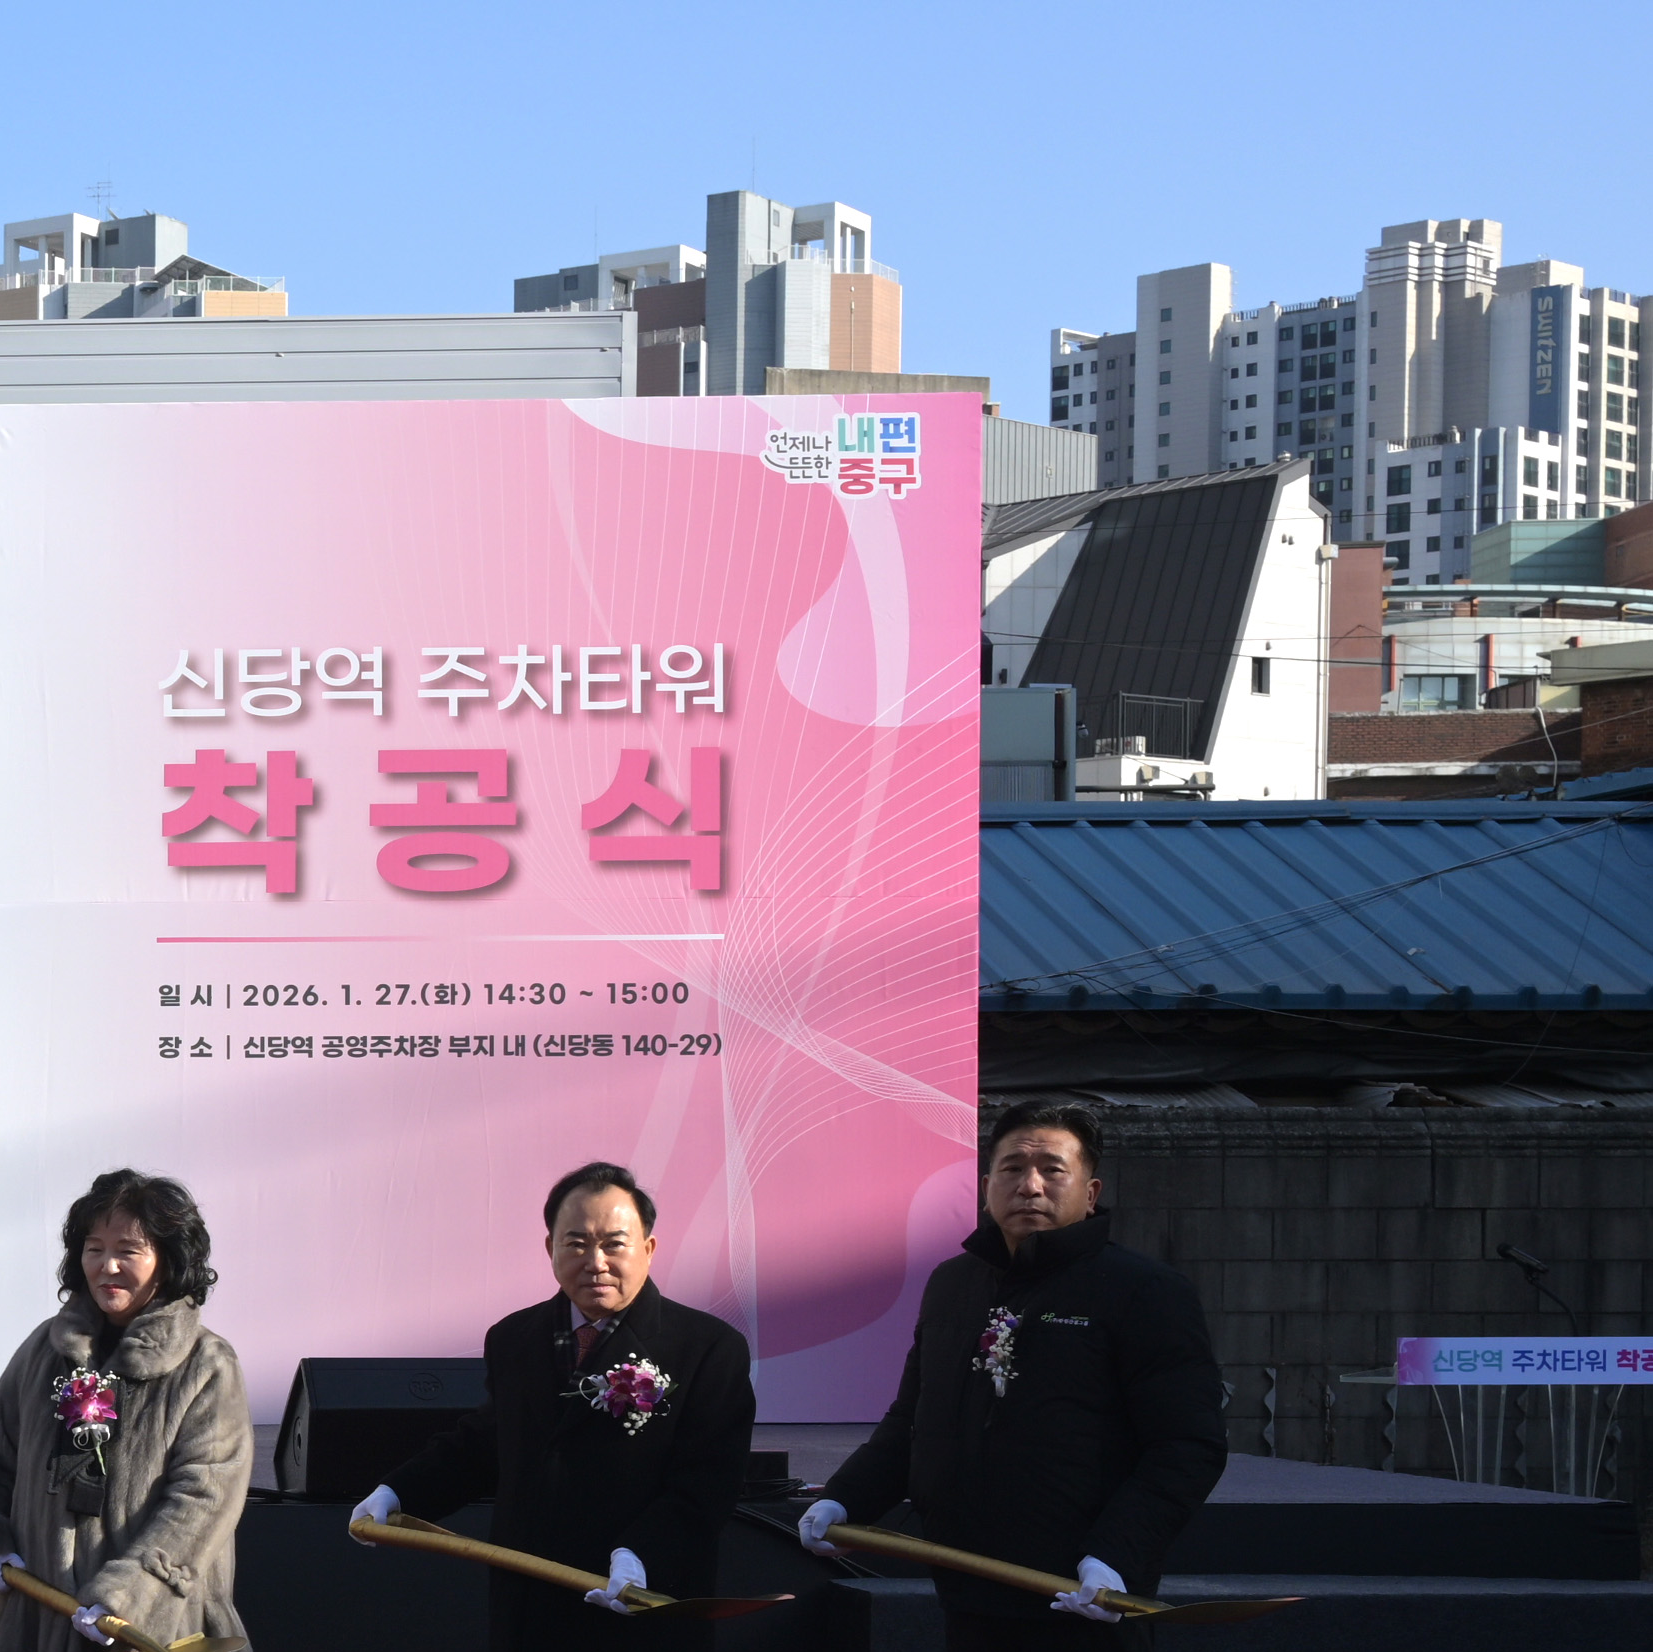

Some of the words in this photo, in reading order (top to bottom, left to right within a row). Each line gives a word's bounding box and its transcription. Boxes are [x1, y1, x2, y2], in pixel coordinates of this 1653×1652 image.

[770, 432, 832, 453] 언제나
[838, 417, 916, 453] 내편
[838, 458, 916, 495] 중구
[158, 647, 385, 718] 신당역
[417, 643, 727, 716] 주차타워
[242, 984, 327, 1007] 2026.
[342, 984, 362, 1006] 1.
[375, 982, 471, 1007] 27.(화)
[484, 983, 566, 1006] 14:30
[607, 982, 689, 1005] 15:00
[242, 1036, 314, 1059] 신당역
[321, 1035, 441, 1059] 공영주차장
[448, 1035, 495, 1058] 부지
[503, 1034, 526, 1058] 내
[532, 1033, 615, 1058] (신당동
[622, 1032, 723, 1057] 140-29)
[1432, 1349, 1503, 1373] 신당역
[1511, 1348, 1607, 1373] 주차타워
